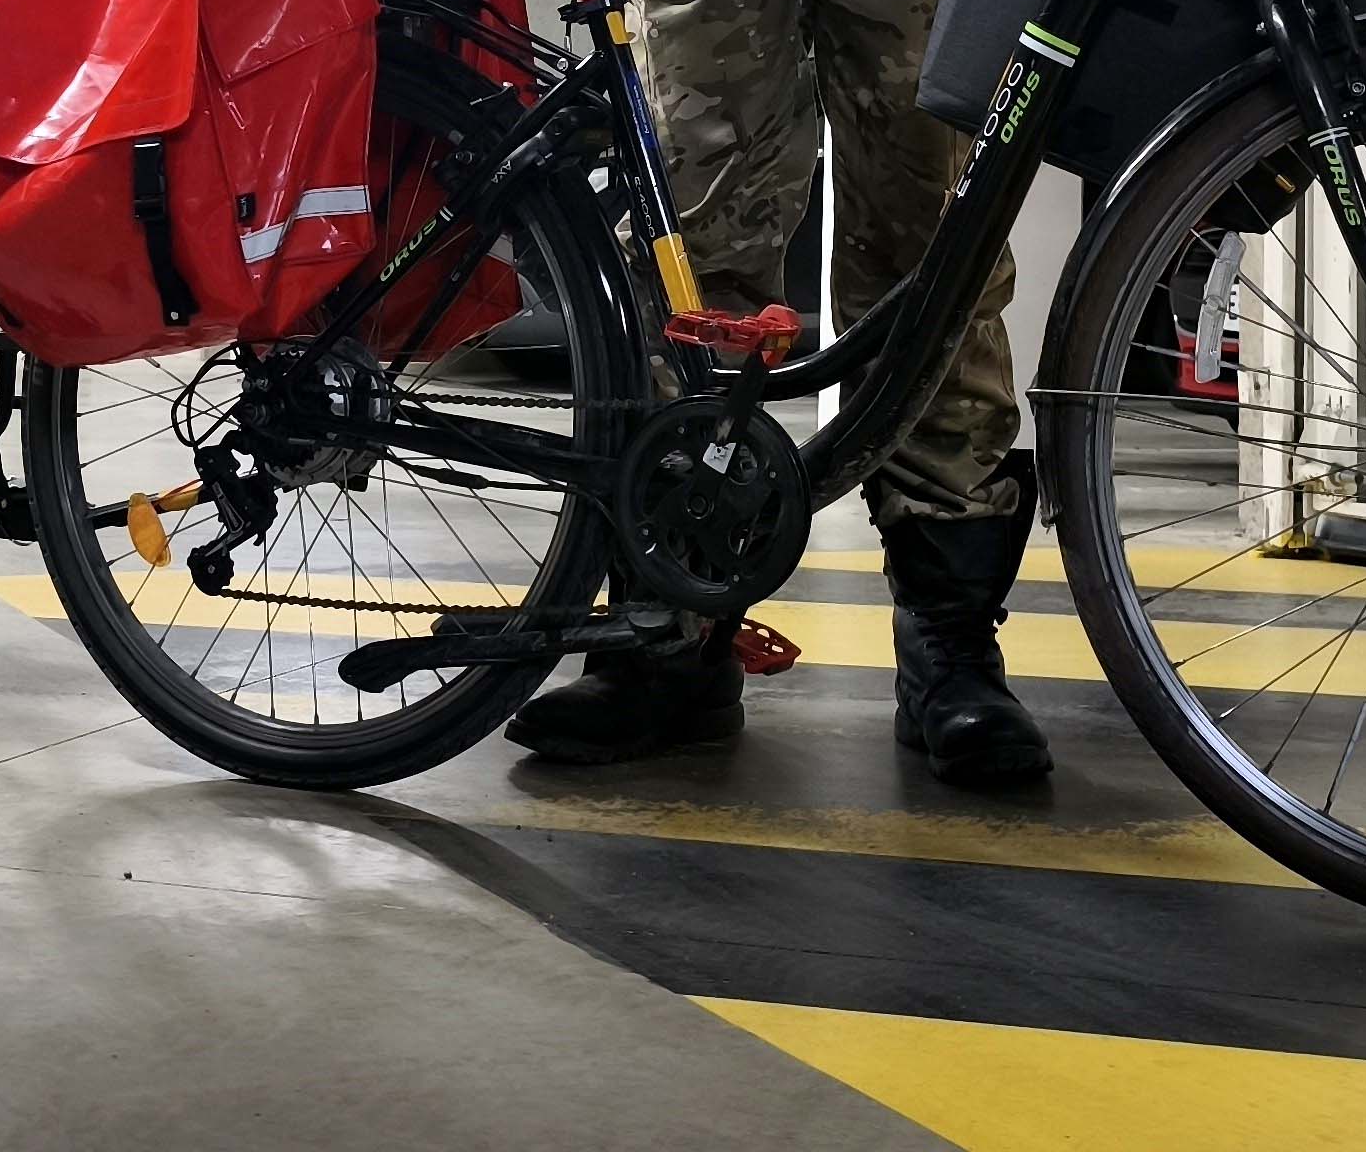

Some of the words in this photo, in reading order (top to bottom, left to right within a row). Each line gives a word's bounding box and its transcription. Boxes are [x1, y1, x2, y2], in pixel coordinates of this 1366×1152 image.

[956, 62, 1024, 199] E-4000
[1000, 70, 1041, 144] ORUS
[1323, 143, 1361, 226] ORUS
